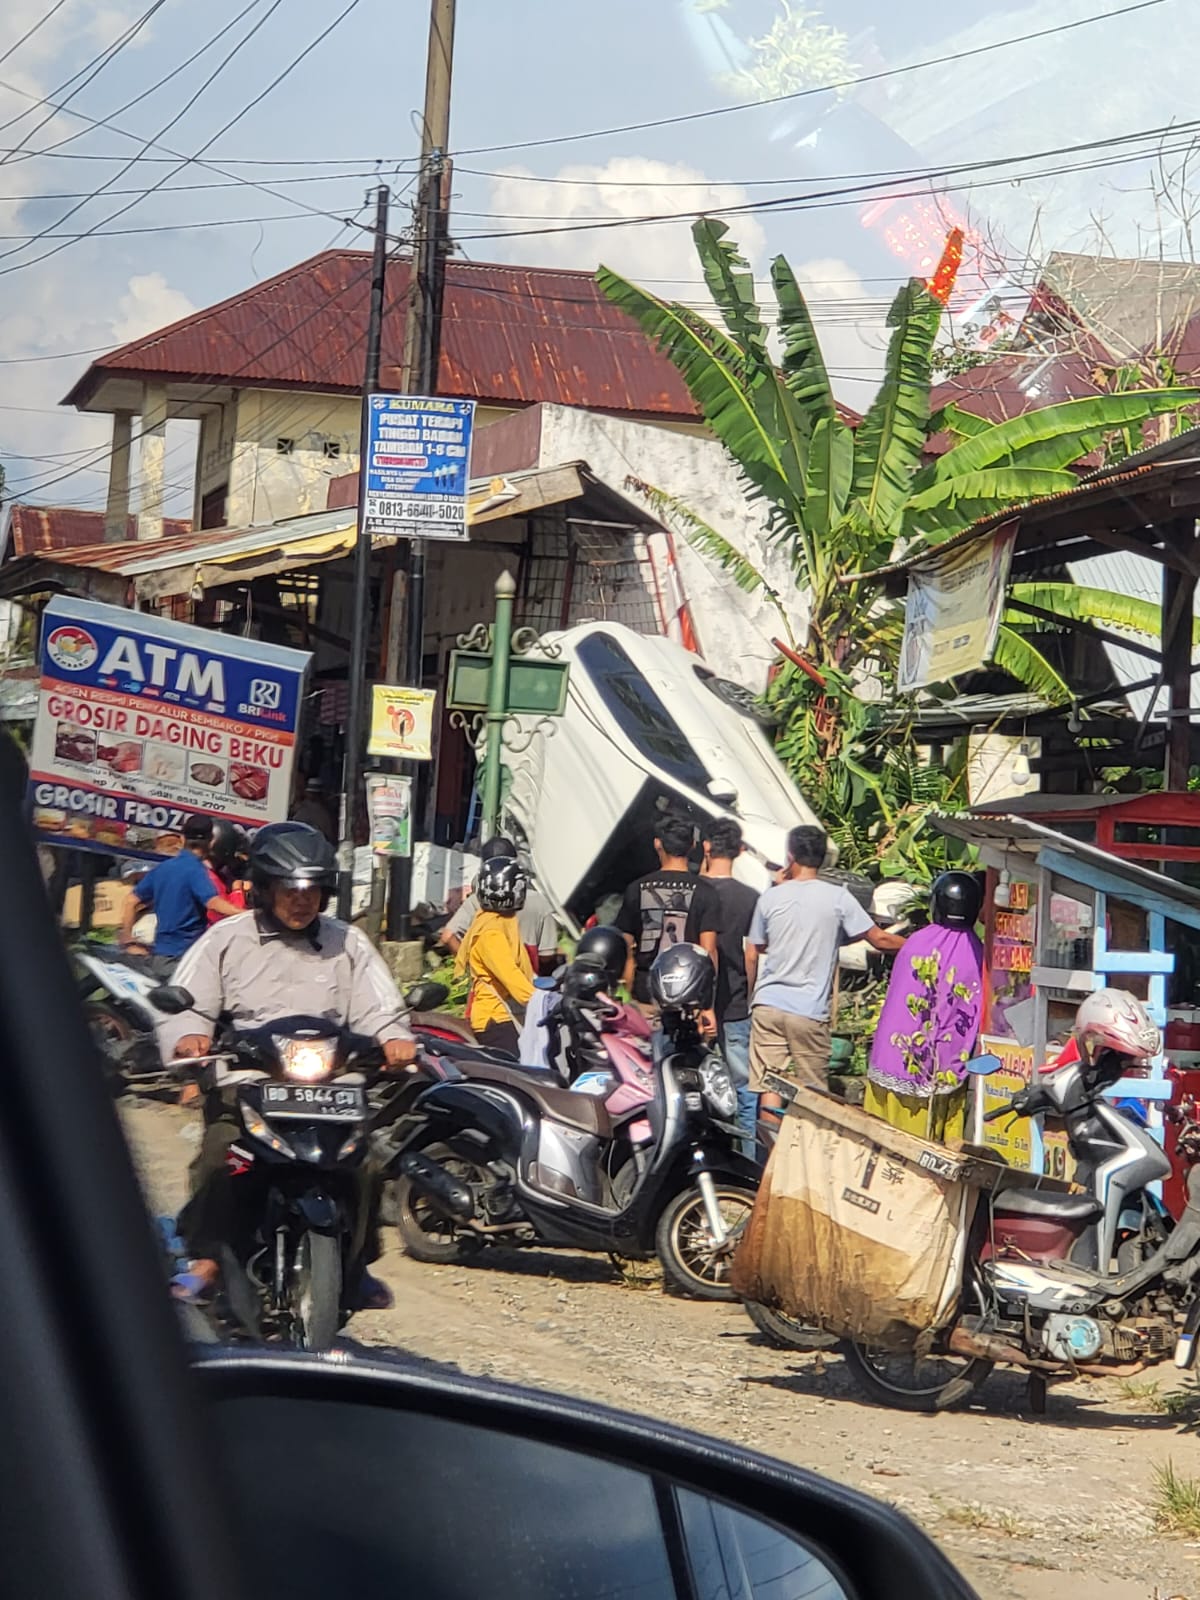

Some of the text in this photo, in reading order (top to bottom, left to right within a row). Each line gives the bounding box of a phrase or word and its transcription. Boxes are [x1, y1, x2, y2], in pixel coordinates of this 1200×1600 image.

[98, 635, 225, 702] ATM
[190, 713, 244, 735] SEMBAKO
[238, 703, 287, 722] BRILink
[47, 695, 284, 768] GROSIR DAGING BEKU
[35, 783, 118, 819] GROSIR
[294, 1088, 334, 1103] 5844
